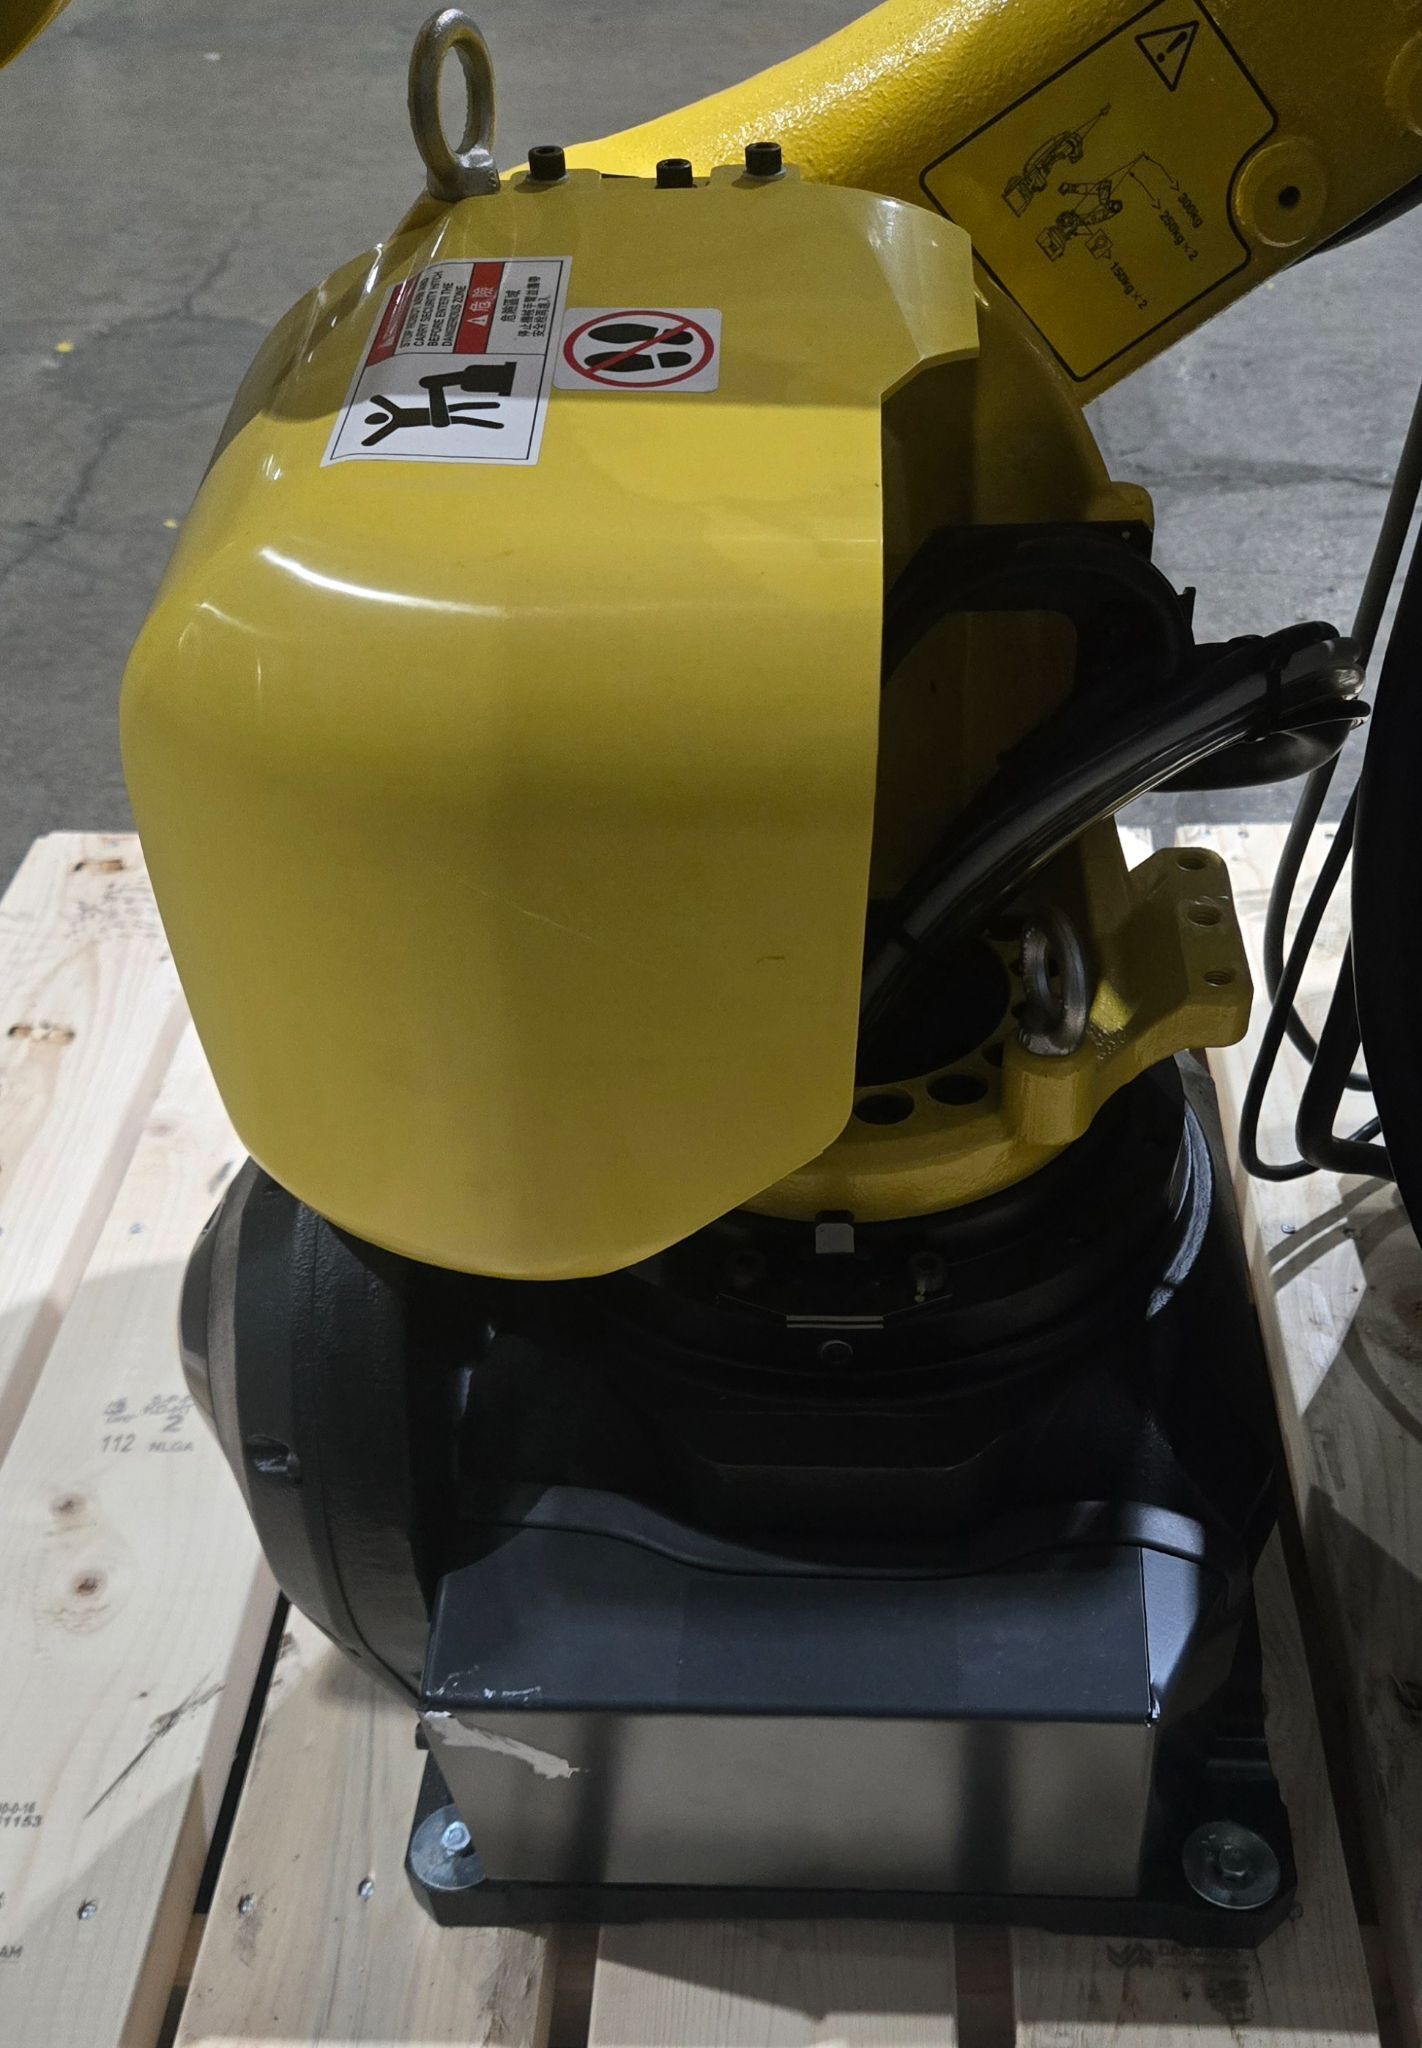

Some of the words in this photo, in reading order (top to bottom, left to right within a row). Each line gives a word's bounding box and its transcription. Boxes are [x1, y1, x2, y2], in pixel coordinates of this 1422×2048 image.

[1178, 192, 1204, 229] 300kg
[1159, 210, 1185, 246] 250kg
[440, 282, 454, 295] THE
[1110, 261, 1135, 296] 150kg
[419, 290, 438, 322] SECURITY
[434, 295, 450, 318] ENTER
[469, 286, 496, 312] 危險
[441, 303, 461, 347] DANGEROUS
[452, 285, 466, 303] ZONE
[413, 322, 429, 347] CARRY
[427, 319, 444, 347] BEFORE
[102, 1433, 136, 1452] 112
